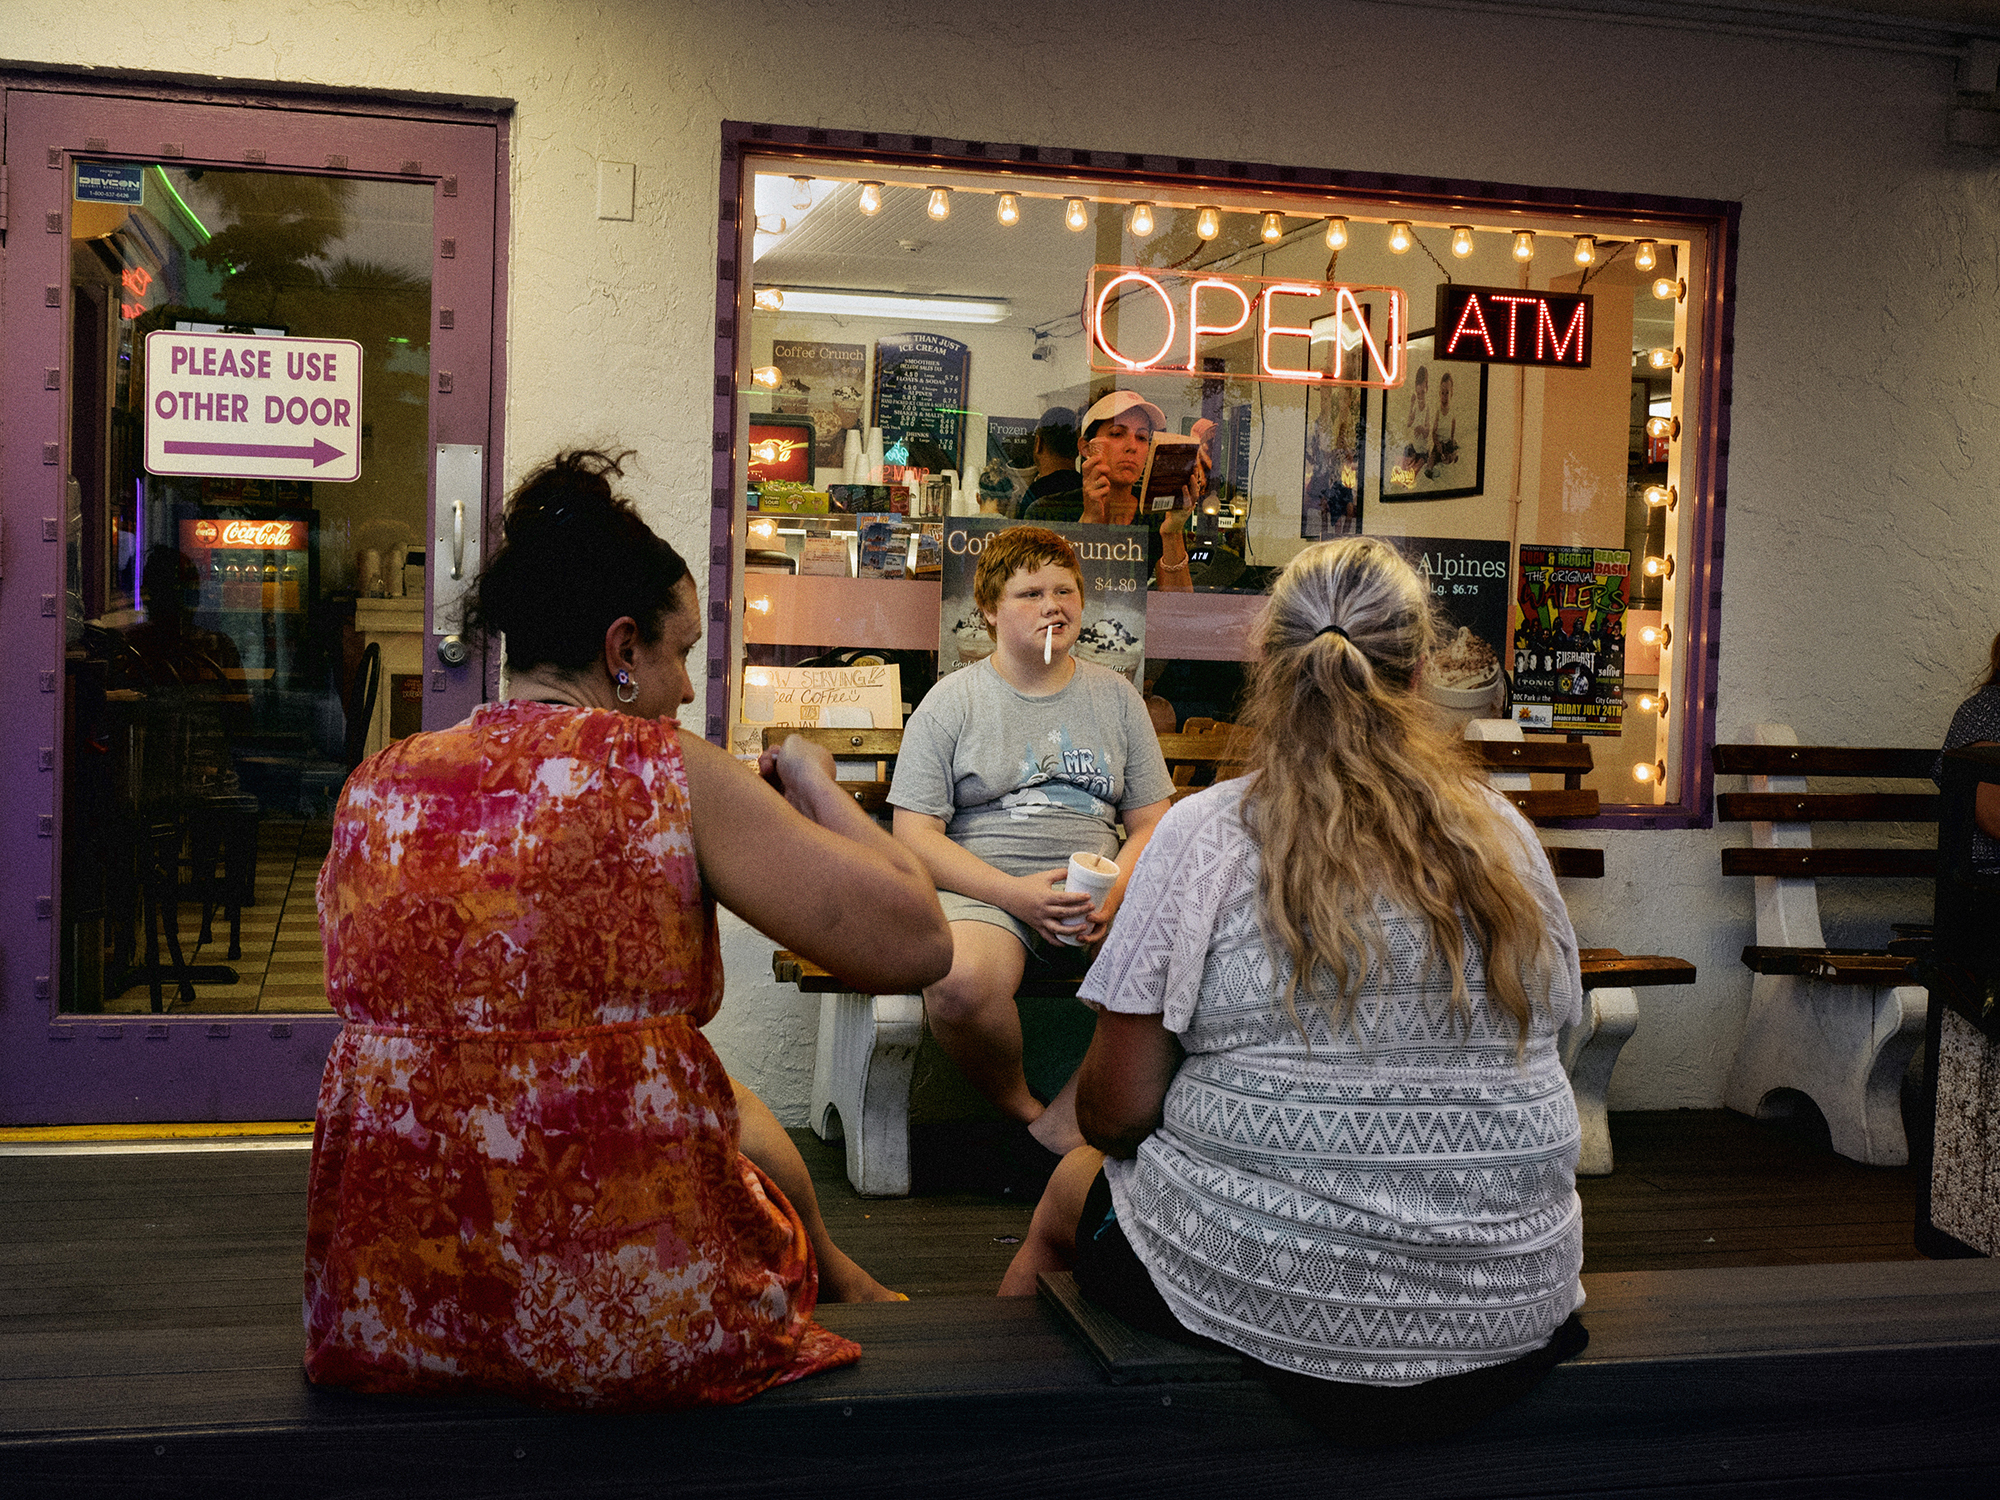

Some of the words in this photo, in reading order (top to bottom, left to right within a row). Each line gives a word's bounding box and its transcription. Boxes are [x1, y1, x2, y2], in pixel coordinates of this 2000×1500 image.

[79, 176, 140, 188] DEVCON
[1095, 271, 1399, 385] OPEN
[1448, 293, 1585, 363] ATM
[899, 343, 914, 352] ICE
[915, 343, 947, 356] CREAM
[913, 334, 938, 344] THAN
[939, 339, 961, 352] JUST
[774, 345, 816, 359] Coffee
[819, 347, 865, 361] Crunch
[171, 345, 271, 379] PLEASE
[287, 351, 337, 382] USE
[155, 390, 249, 423] OTHER
[264, 395, 351, 428] DOOR
[989, 422, 1028, 436] Frozen
[222, 521, 294, 546] Coca-Cola
[1191, 552, 1209, 560] ATM
[1558, 553, 1592, 567] REGGAE
[1593, 549, 1630, 564] BEACH
[1416, 552, 1507, 581] Alpines
[1594, 562, 1628, 576] BASH
[1094, 576, 1137, 592] $4.80
[1526, 571, 1547, 582] THE
[1431, 582, 1447, 596] Lg.
[1452, 584, 1479, 596] $6.75
[1556, 651, 1596, 675] EVERLAST
[774, 689, 795, 704] ced
[1524, 694, 1536, 702] Park
[1542, 694, 1552, 702] the
[1595, 696, 1606, 706] City
[1554, 703, 1582, 715] FRIDAY
[1582, 704, 1602, 716] JULY
[1602, 705, 1622, 717] 24TH
[1062, 748, 1102, 775] MR.
